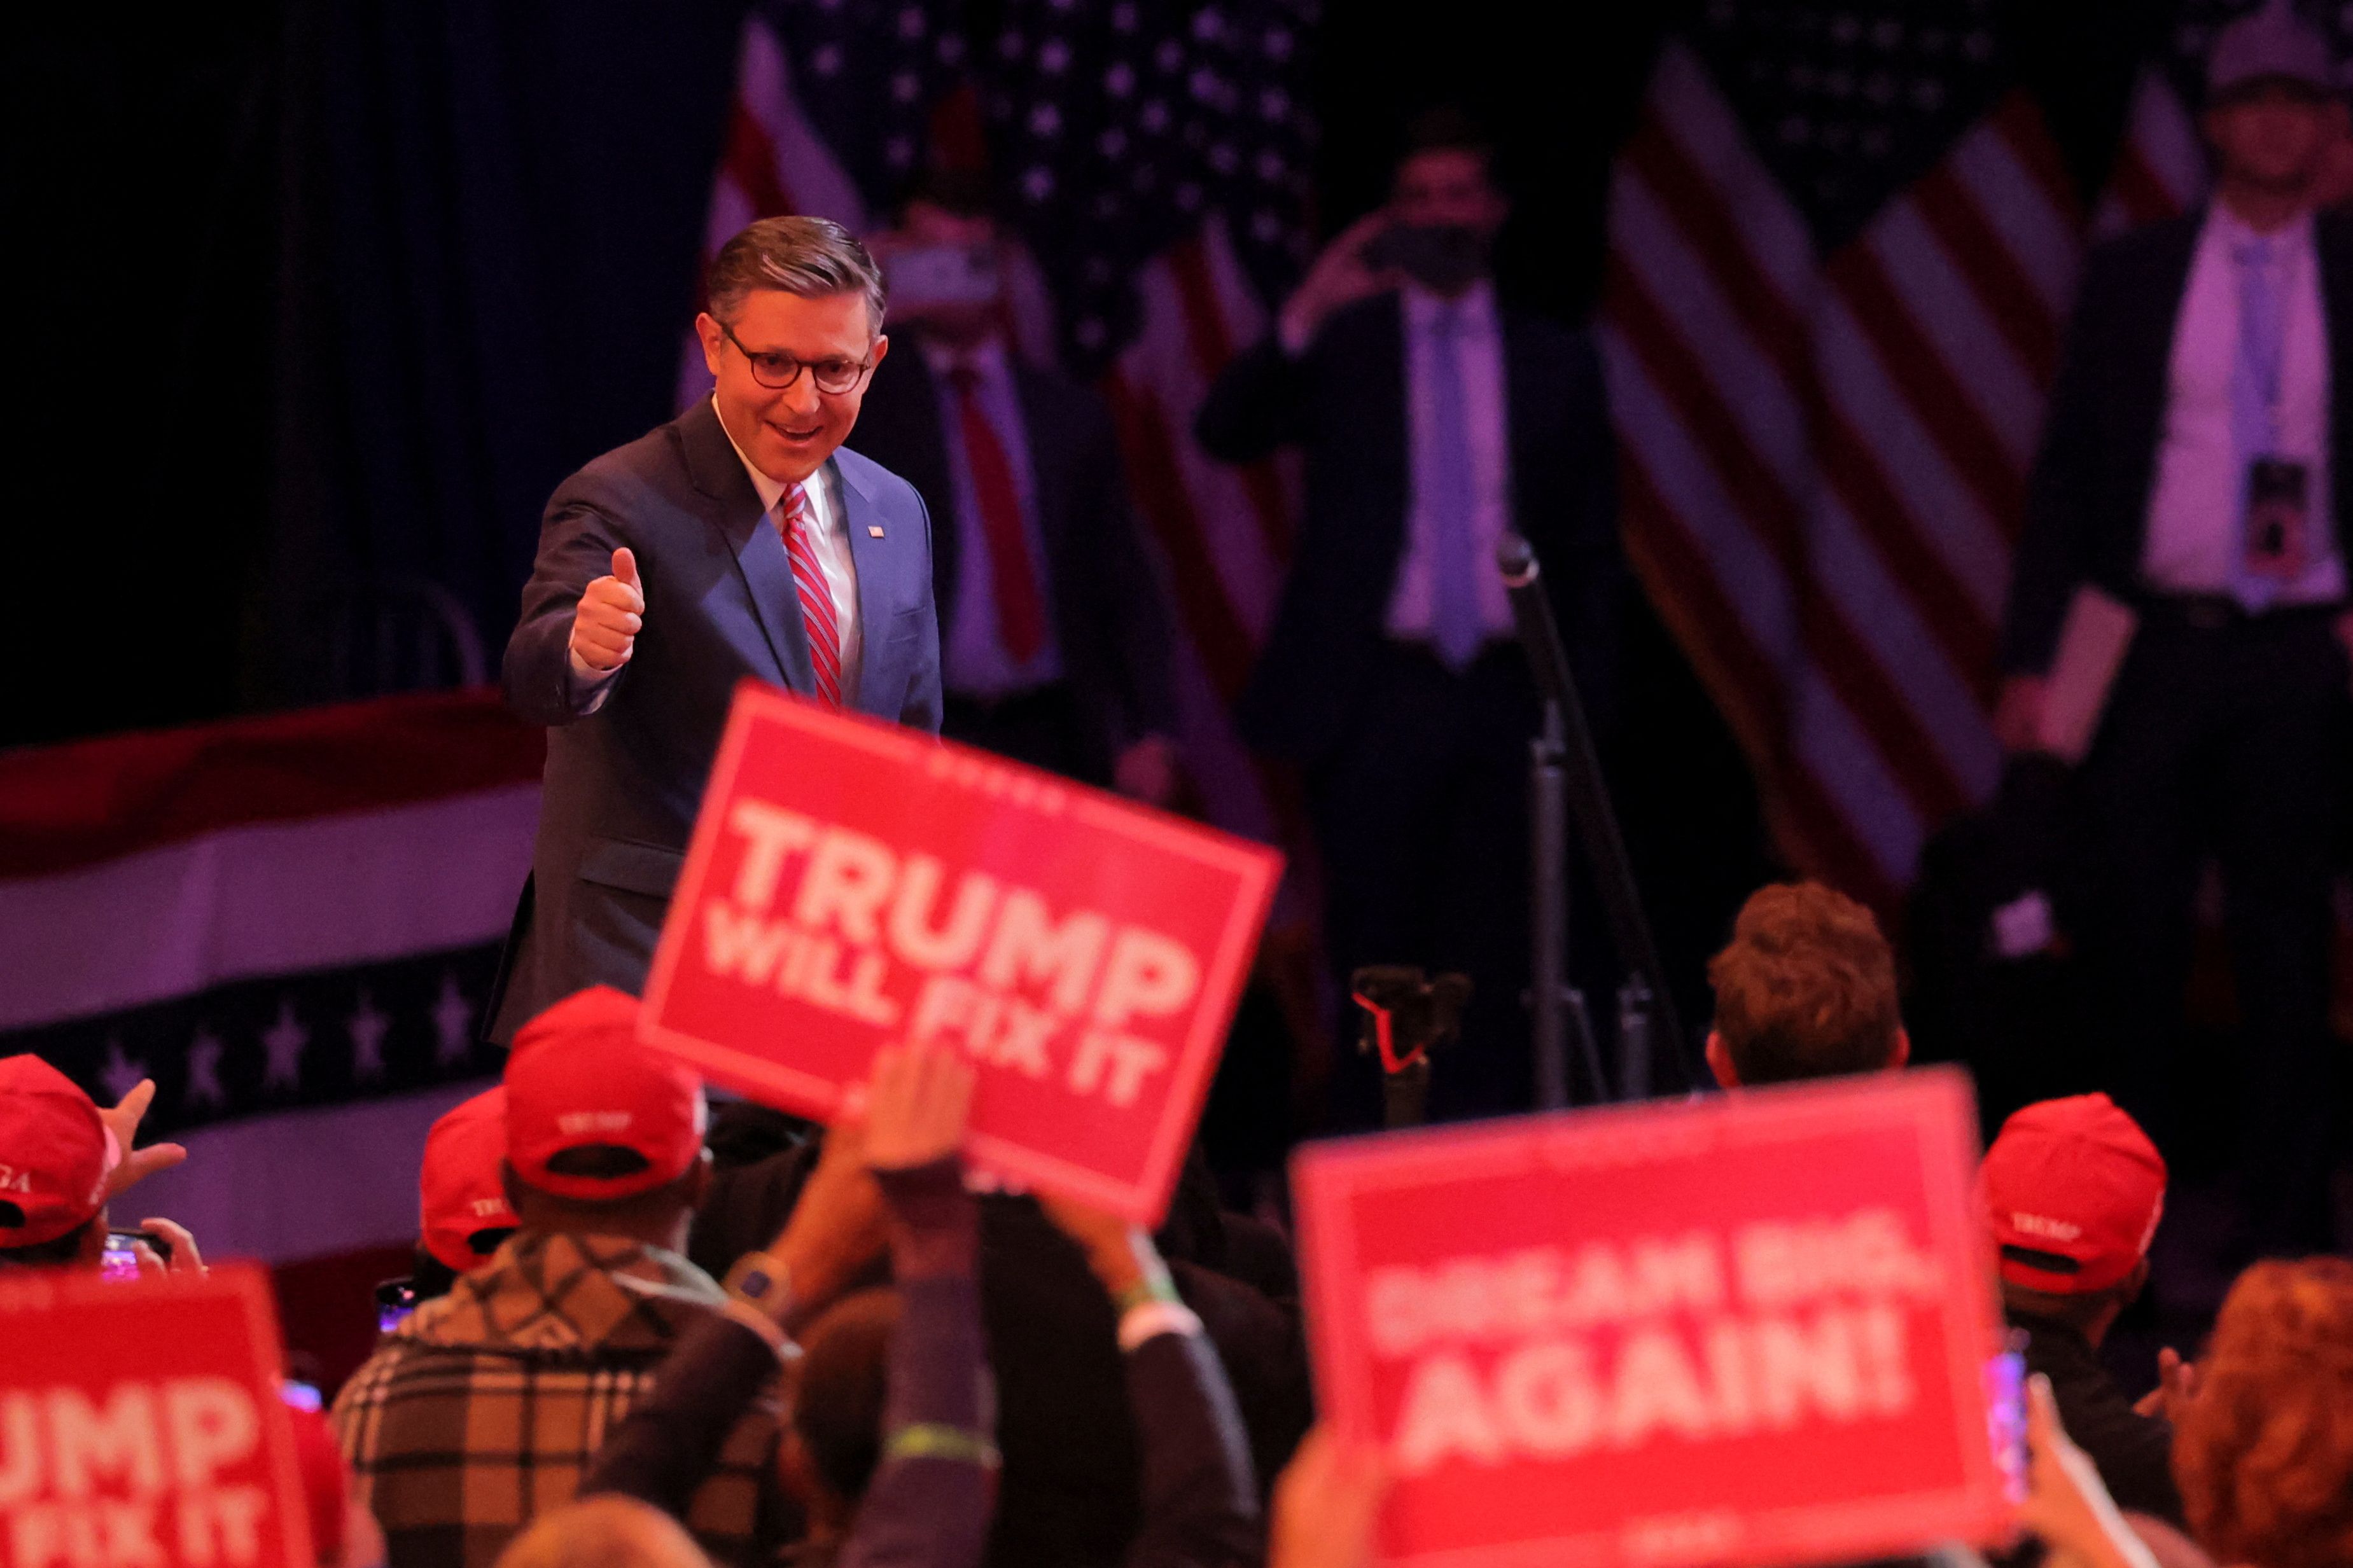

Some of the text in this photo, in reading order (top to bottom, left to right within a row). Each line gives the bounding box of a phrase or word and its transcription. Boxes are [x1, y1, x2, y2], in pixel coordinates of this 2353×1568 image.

[702, 896, 1170, 1109] WILL FIX IT
[729, 798, 1204, 1030] TRUMP
[1395, 1301, 1914, 1474] AGAIN!
[176, 1483, 271, 1564] IT
